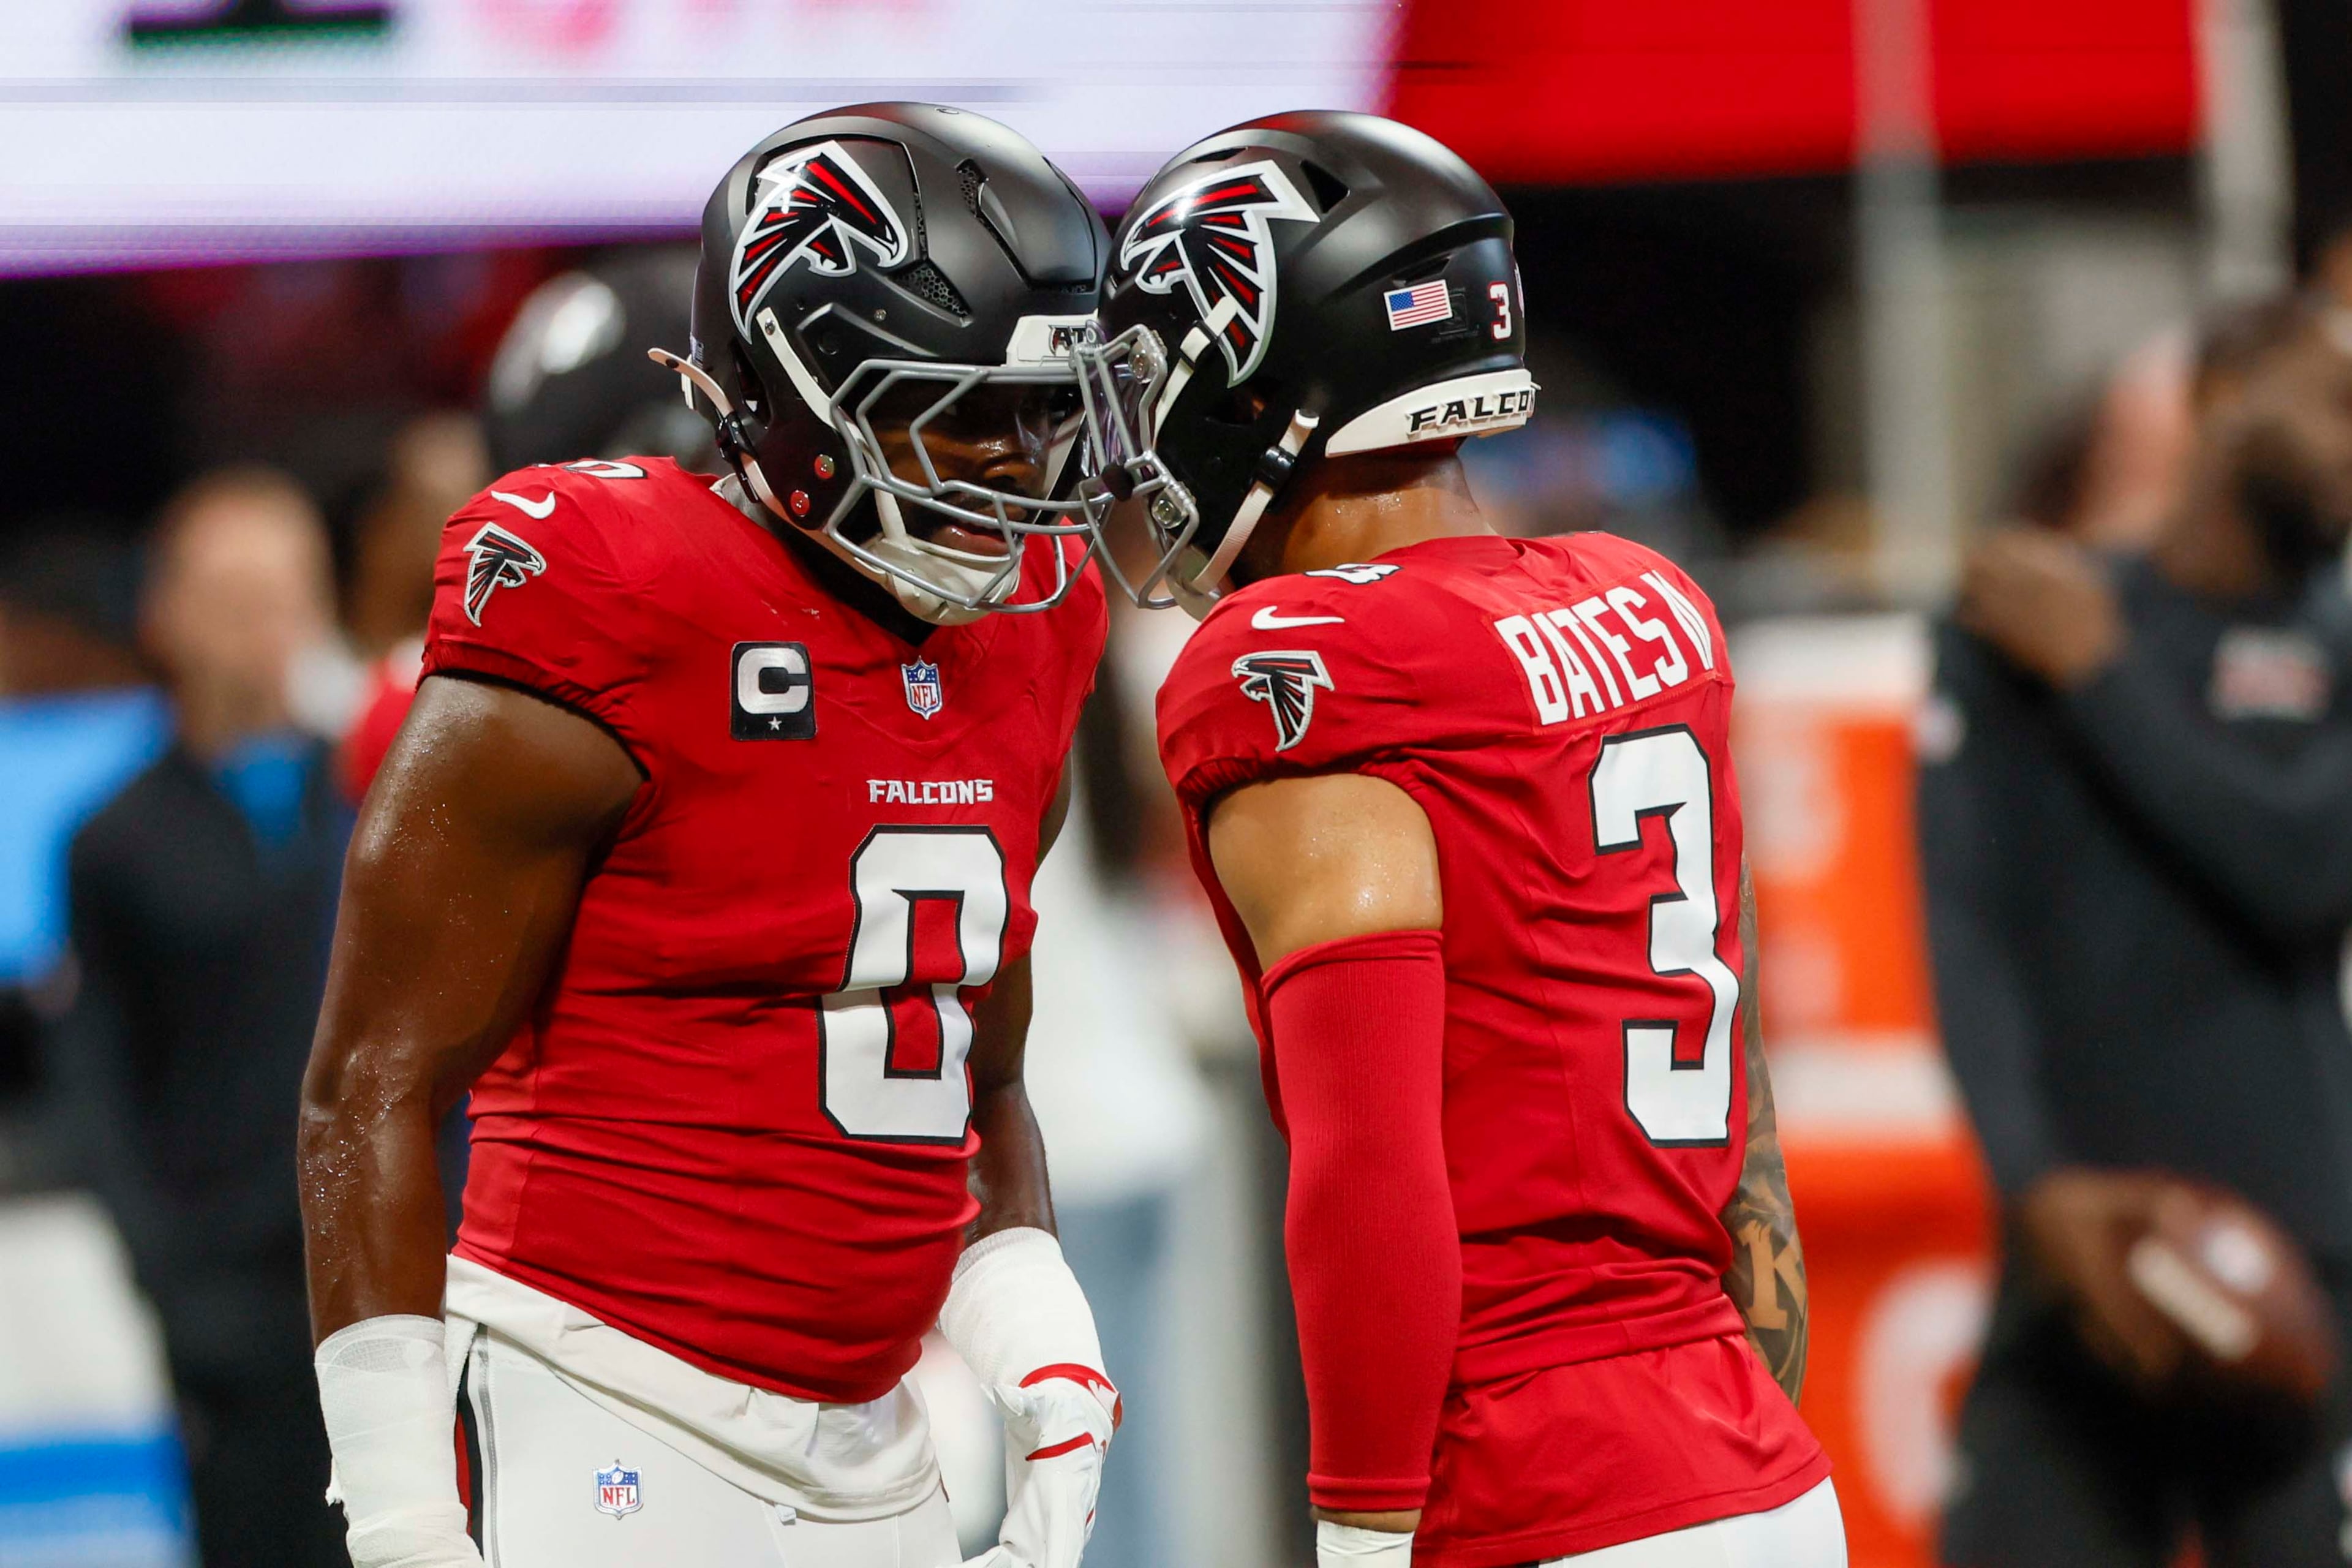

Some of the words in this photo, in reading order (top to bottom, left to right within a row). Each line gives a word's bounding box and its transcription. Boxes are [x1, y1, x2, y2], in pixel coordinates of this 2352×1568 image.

[1487, 280, 1512, 342] 3
[1408, 390, 1536, 432] FALCO
[737, 647, 809, 715] C
[1493, 586, 1689, 726] BATES
[911, 685, 937, 708] NFL
[865, 779, 993, 805] FALCONS
[1588, 723, 1741, 1148] 3
[813, 823, 1011, 1147] 0
[601, 1486, 636, 1507] NFL
